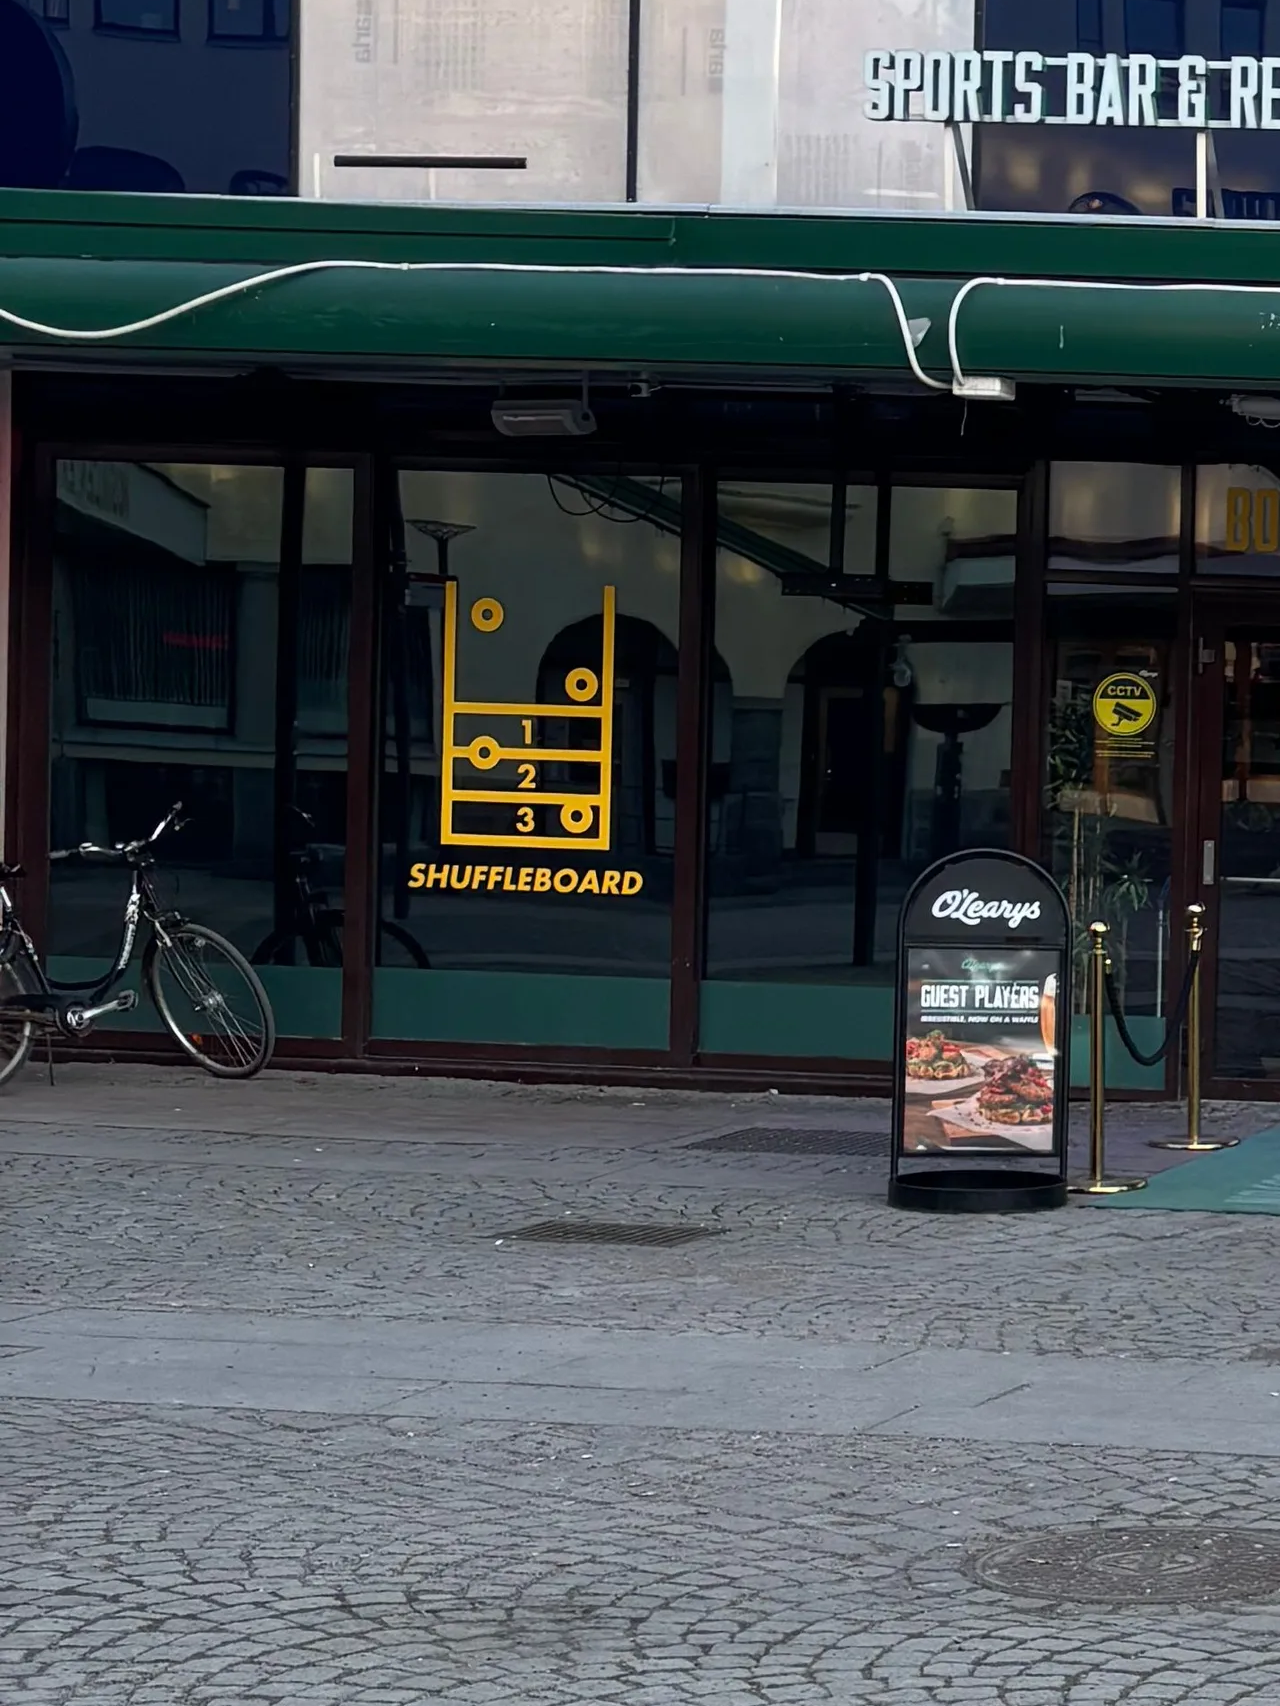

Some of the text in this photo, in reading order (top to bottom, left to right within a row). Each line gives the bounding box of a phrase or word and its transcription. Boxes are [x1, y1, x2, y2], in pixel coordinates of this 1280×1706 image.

[863, 50, 1045, 123] SPORTS
[1067, 52, 1157, 126] BAR
[1178, 55, 1206, 127] &
[1107, 685, 1142, 696] CCTV
[521, 719, 532, 744] 1
[517, 764, 536, 788] 2
[516, 807, 535, 833] 3
[408, 863, 643, 895] SHUFFLEBOARD
[931, 889, 1041, 928] O'Learys
[920, 984, 1039, 1009] GUEST PLAYERS
